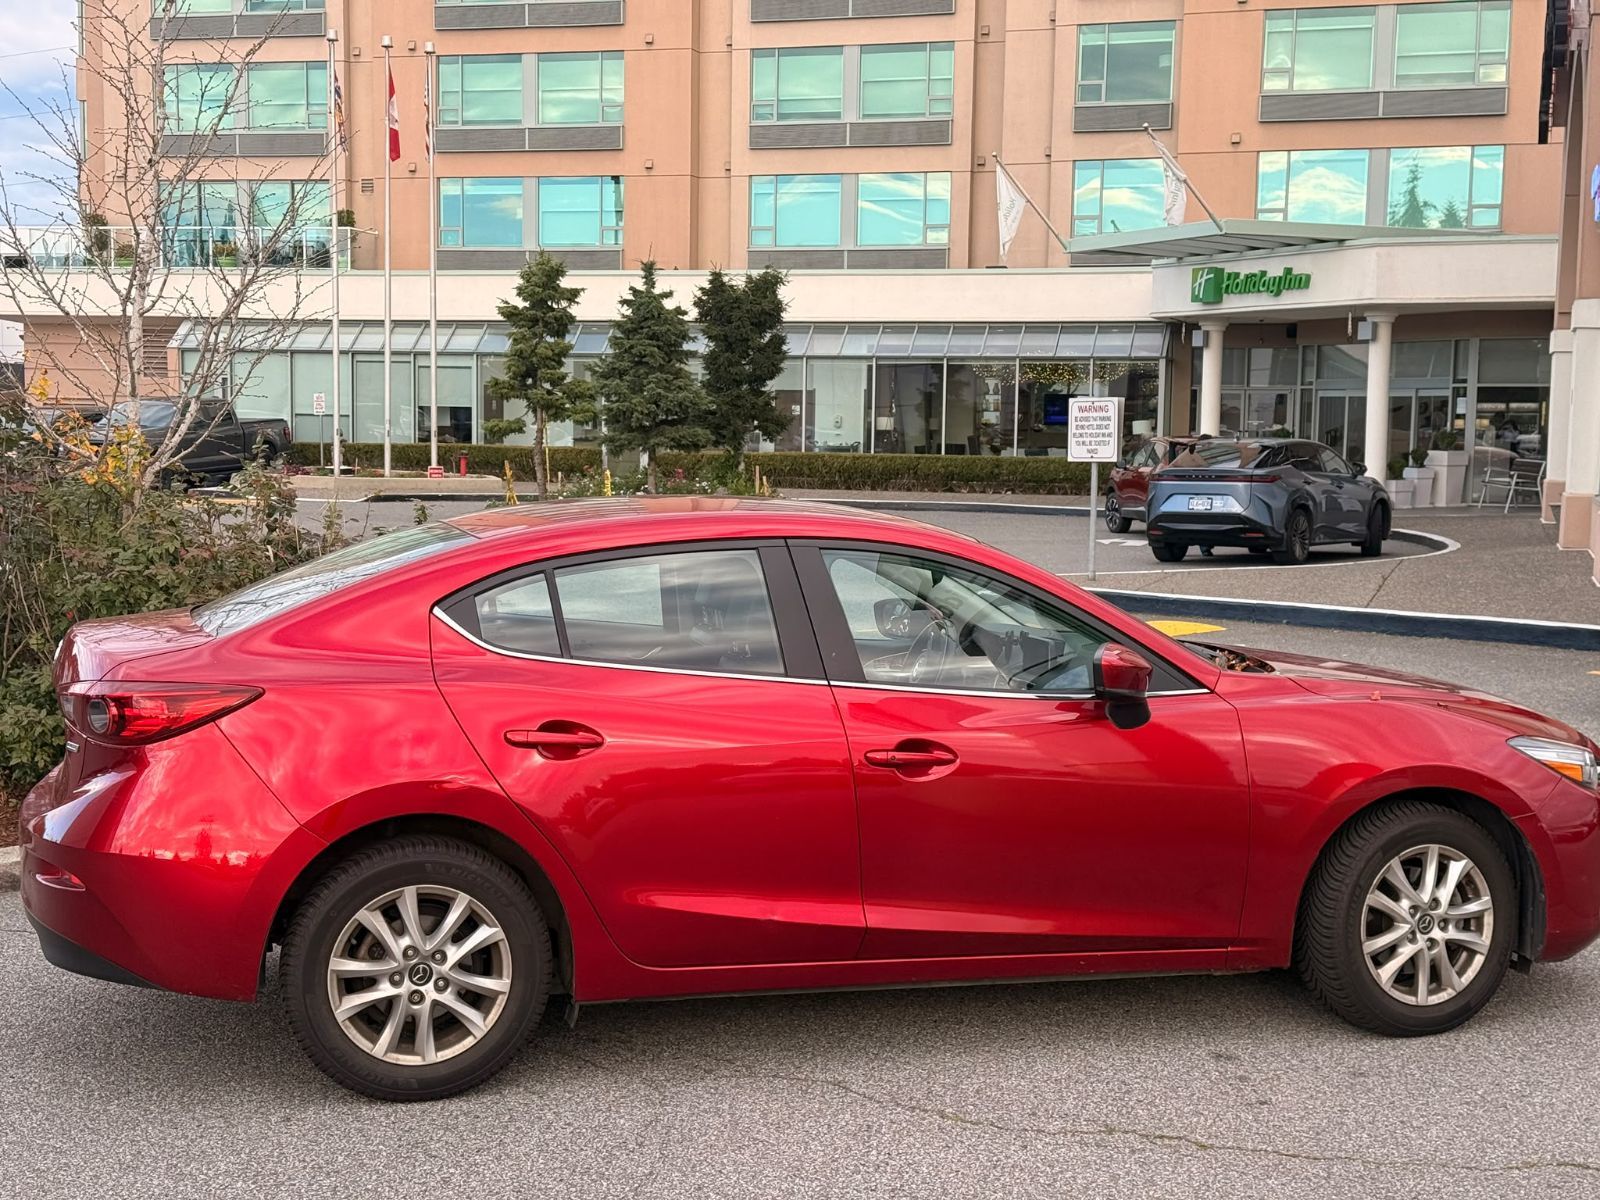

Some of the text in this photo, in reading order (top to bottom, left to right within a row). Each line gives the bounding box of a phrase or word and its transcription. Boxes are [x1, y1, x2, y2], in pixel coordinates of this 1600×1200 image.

[1221, 267, 1311, 297] Holiday Inn
[1078, 404, 1109, 413] WARNING
